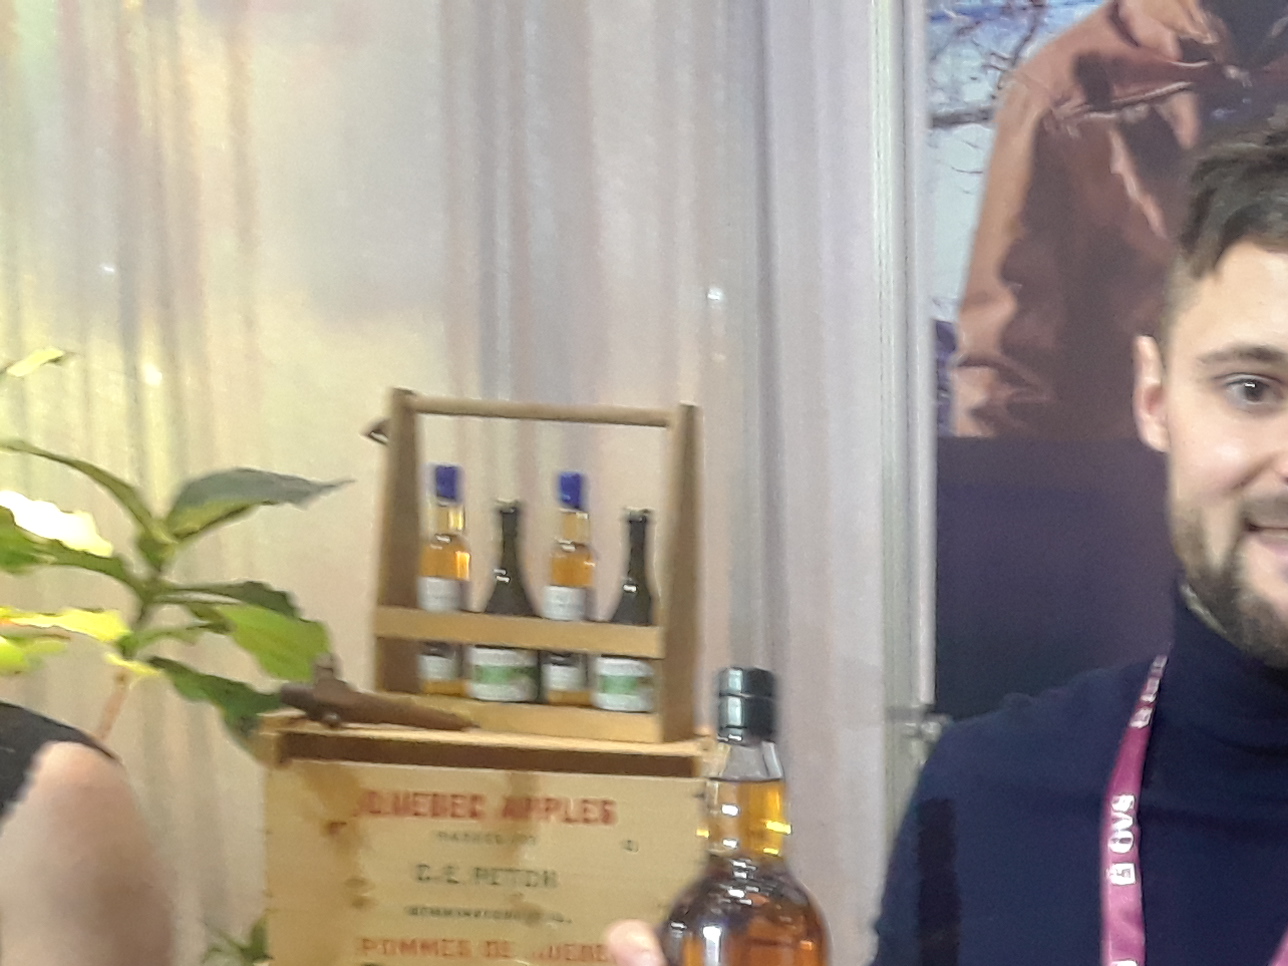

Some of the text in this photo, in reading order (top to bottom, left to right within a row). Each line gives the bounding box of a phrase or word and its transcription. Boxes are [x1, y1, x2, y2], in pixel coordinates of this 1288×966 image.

[360, 790, 617, 827] QUEBEC APPLES
[361, 937, 474, 961] POMMES
[483, 937, 516, 960] DE
